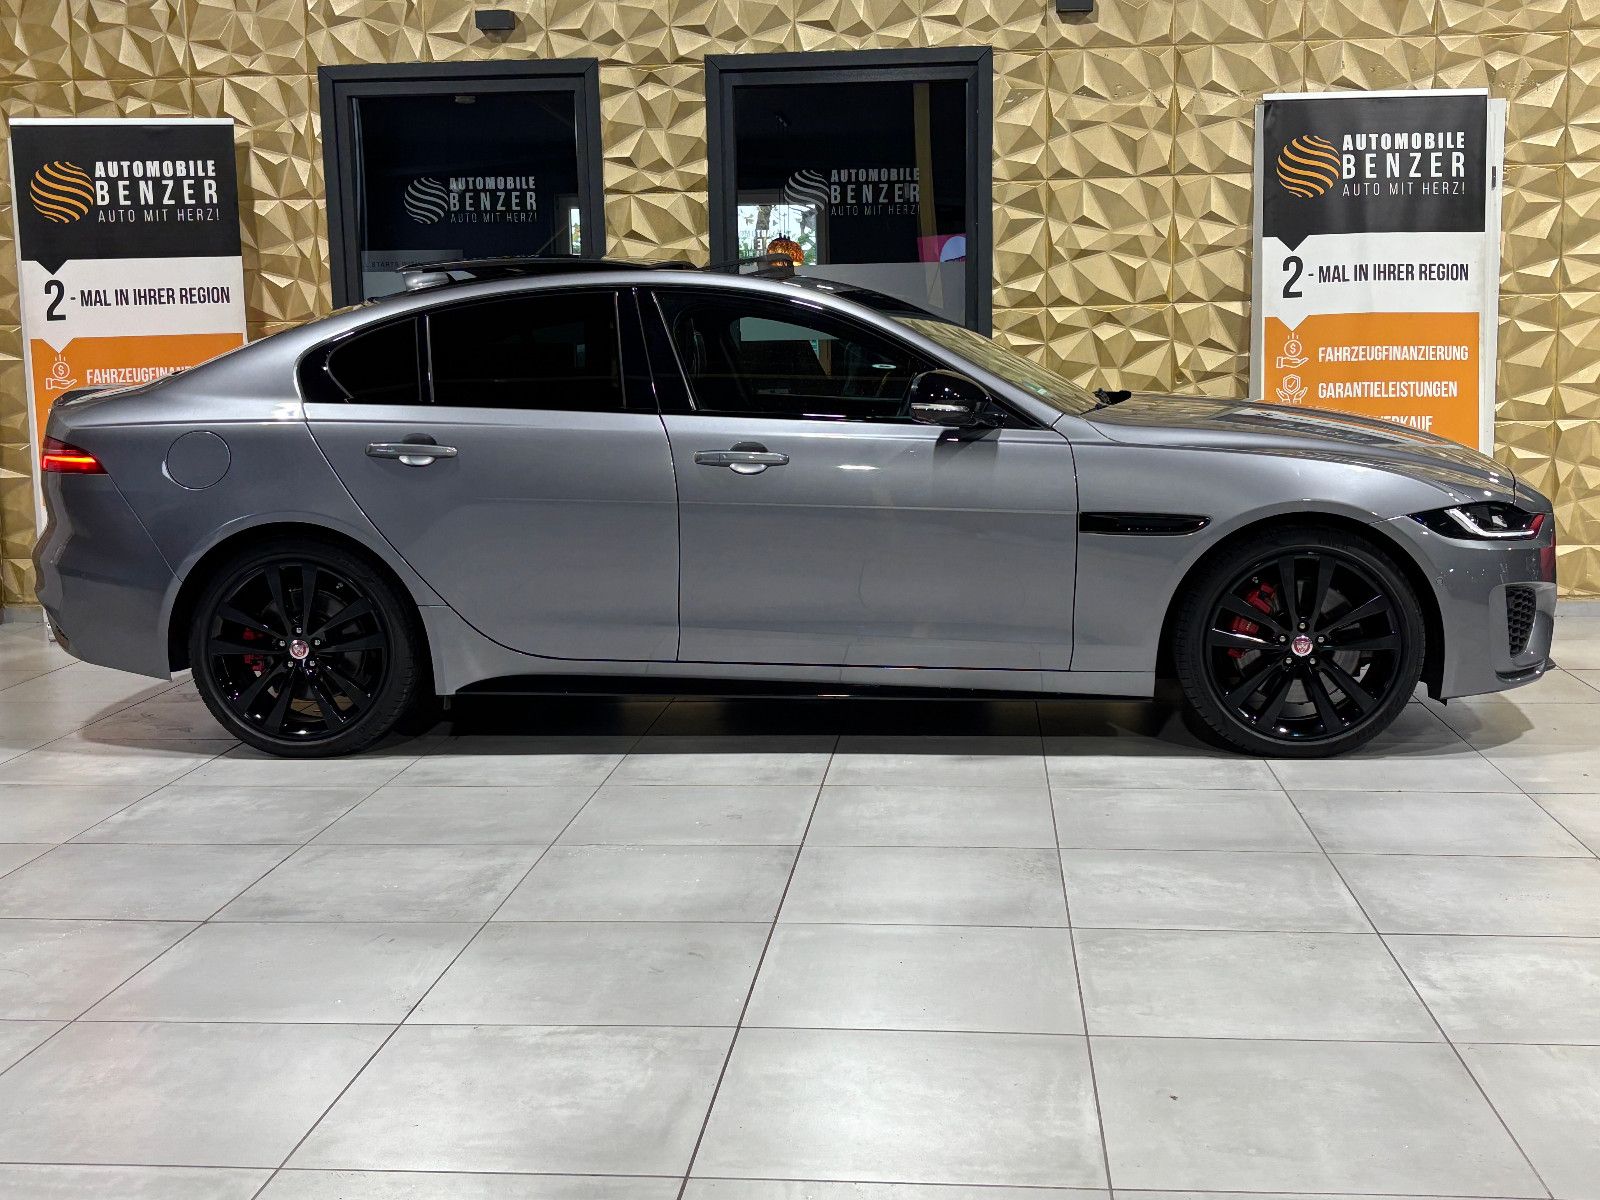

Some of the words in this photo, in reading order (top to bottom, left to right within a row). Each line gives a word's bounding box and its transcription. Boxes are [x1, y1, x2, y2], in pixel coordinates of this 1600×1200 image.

[1342, 131, 1465, 151] AUTOMOBILE
[94, 160, 217, 178] AUTOMOBILE
[830, 167, 920, 182] AUTOMOBILE
[1342, 151, 1465, 180] BENZER
[449, 176, 536, 190] AUTOMOBILE
[1342, 182, 1380, 197] AUTO
[1389, 181, 1414, 196] MIT
[1422, 181, 1465, 195] HERZ!
[95, 179, 218, 206] BENZER
[449, 191, 537, 211] BENZER
[830, 183, 920, 204] BENZER
[98, 209, 136, 223] AUTO
[144, 208, 168, 222] MIT
[177, 208, 220, 222] HERZ!
[450, 213, 477, 223] AUTO
[483, 212, 501, 223] MIT
[830, 206, 859, 216] AUTO
[864, 205, 882, 216] MIT
[1282, 255, 1304, 299] 2
[1318, 264, 1350, 284] MAL
[1353, 263, 1370, 282] IN
[1372, 263, 1415, 282] IHRER
[1418, 263, 1469, 281] REGION
[44, 279, 67, 322] 2
[80, 289, 112, 307] MAL
[114, 288, 130, 306] IN
[132, 287, 176, 306] IHRER
[179, 286, 231, 304] REGION
[1318, 345, 1469, 363] FAHRZEUGFINANZIERUNG
[86, 366, 192, 384] FAHRZEUGFIN
[1318, 380, 1458, 399] GARANTIELEISTUNGEN
[1376, 415, 1434, 432] KAUF
